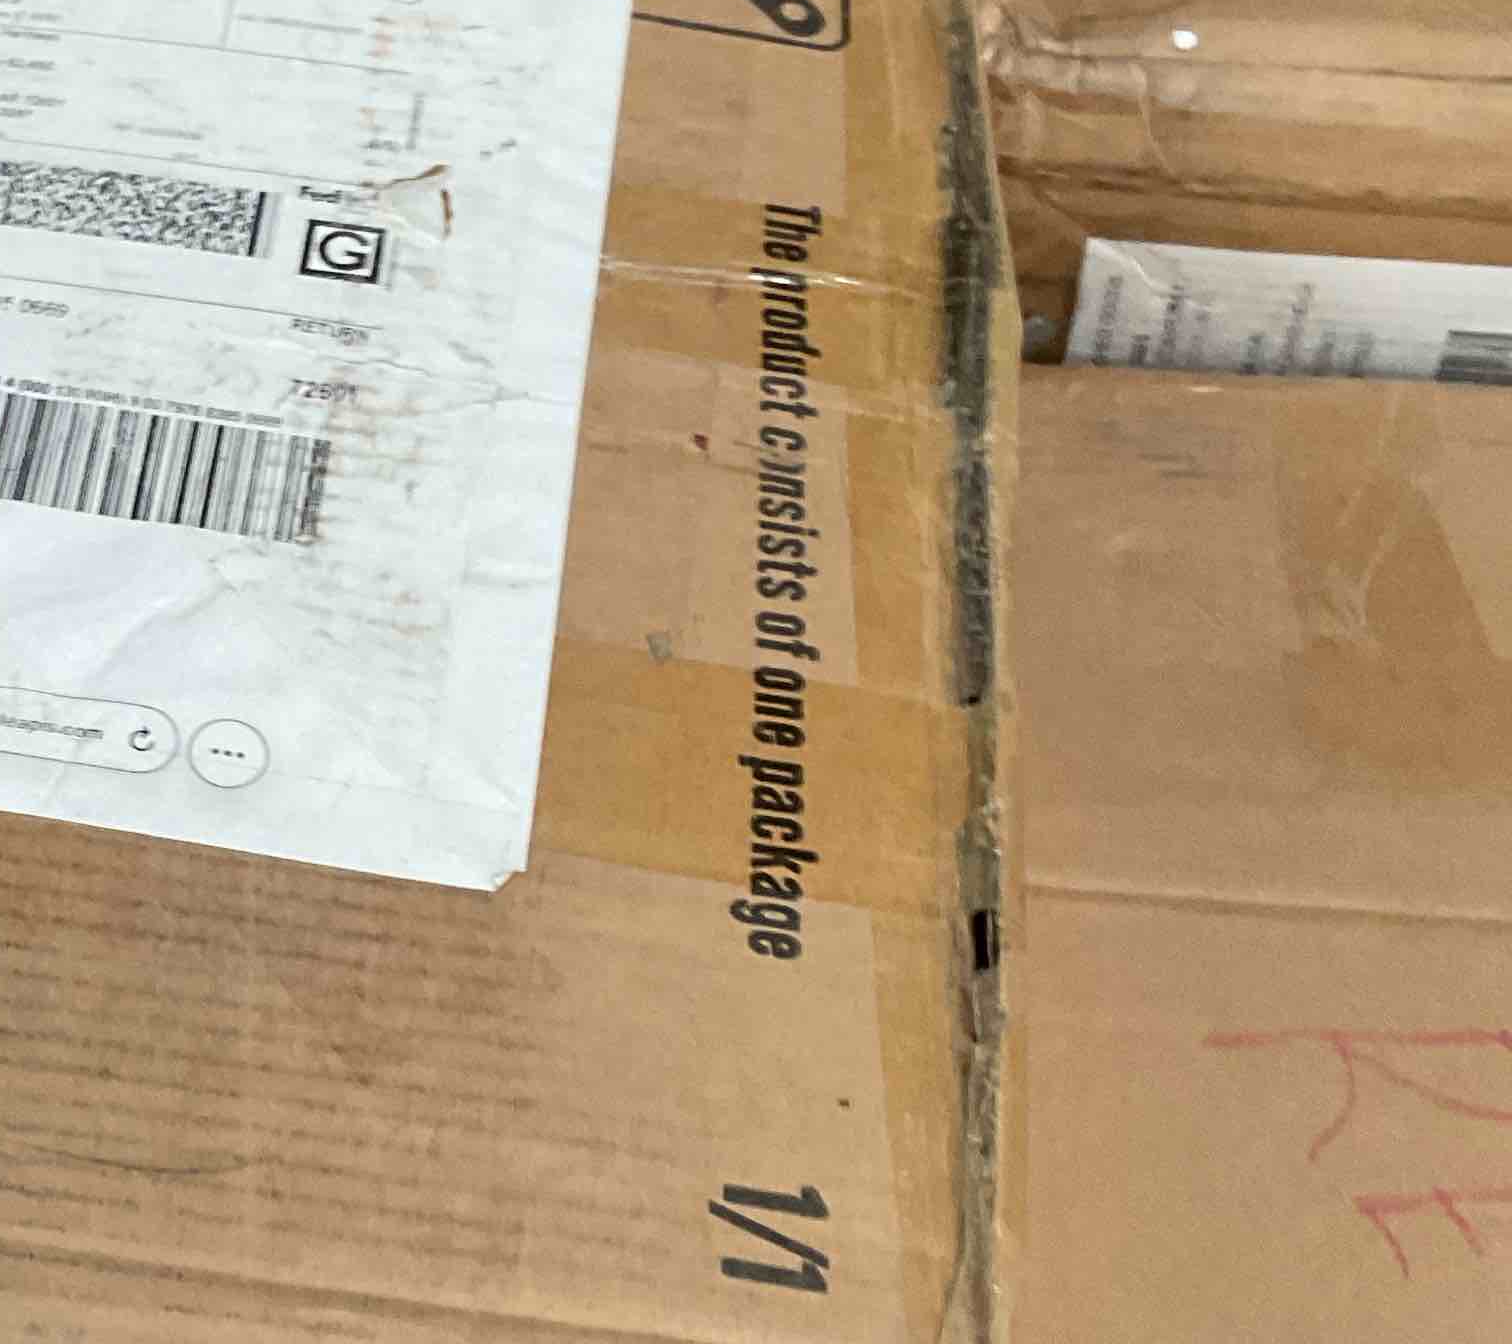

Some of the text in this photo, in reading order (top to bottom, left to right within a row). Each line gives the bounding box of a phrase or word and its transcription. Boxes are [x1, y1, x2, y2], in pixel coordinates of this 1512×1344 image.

[318, 230, 371, 271] G
[764, 203, 824, 263] The
[749, 265, 823, 420] product
[754, 609, 822, 663] of
[752, 665, 807, 748] one
[729, 754, 821, 961] package
